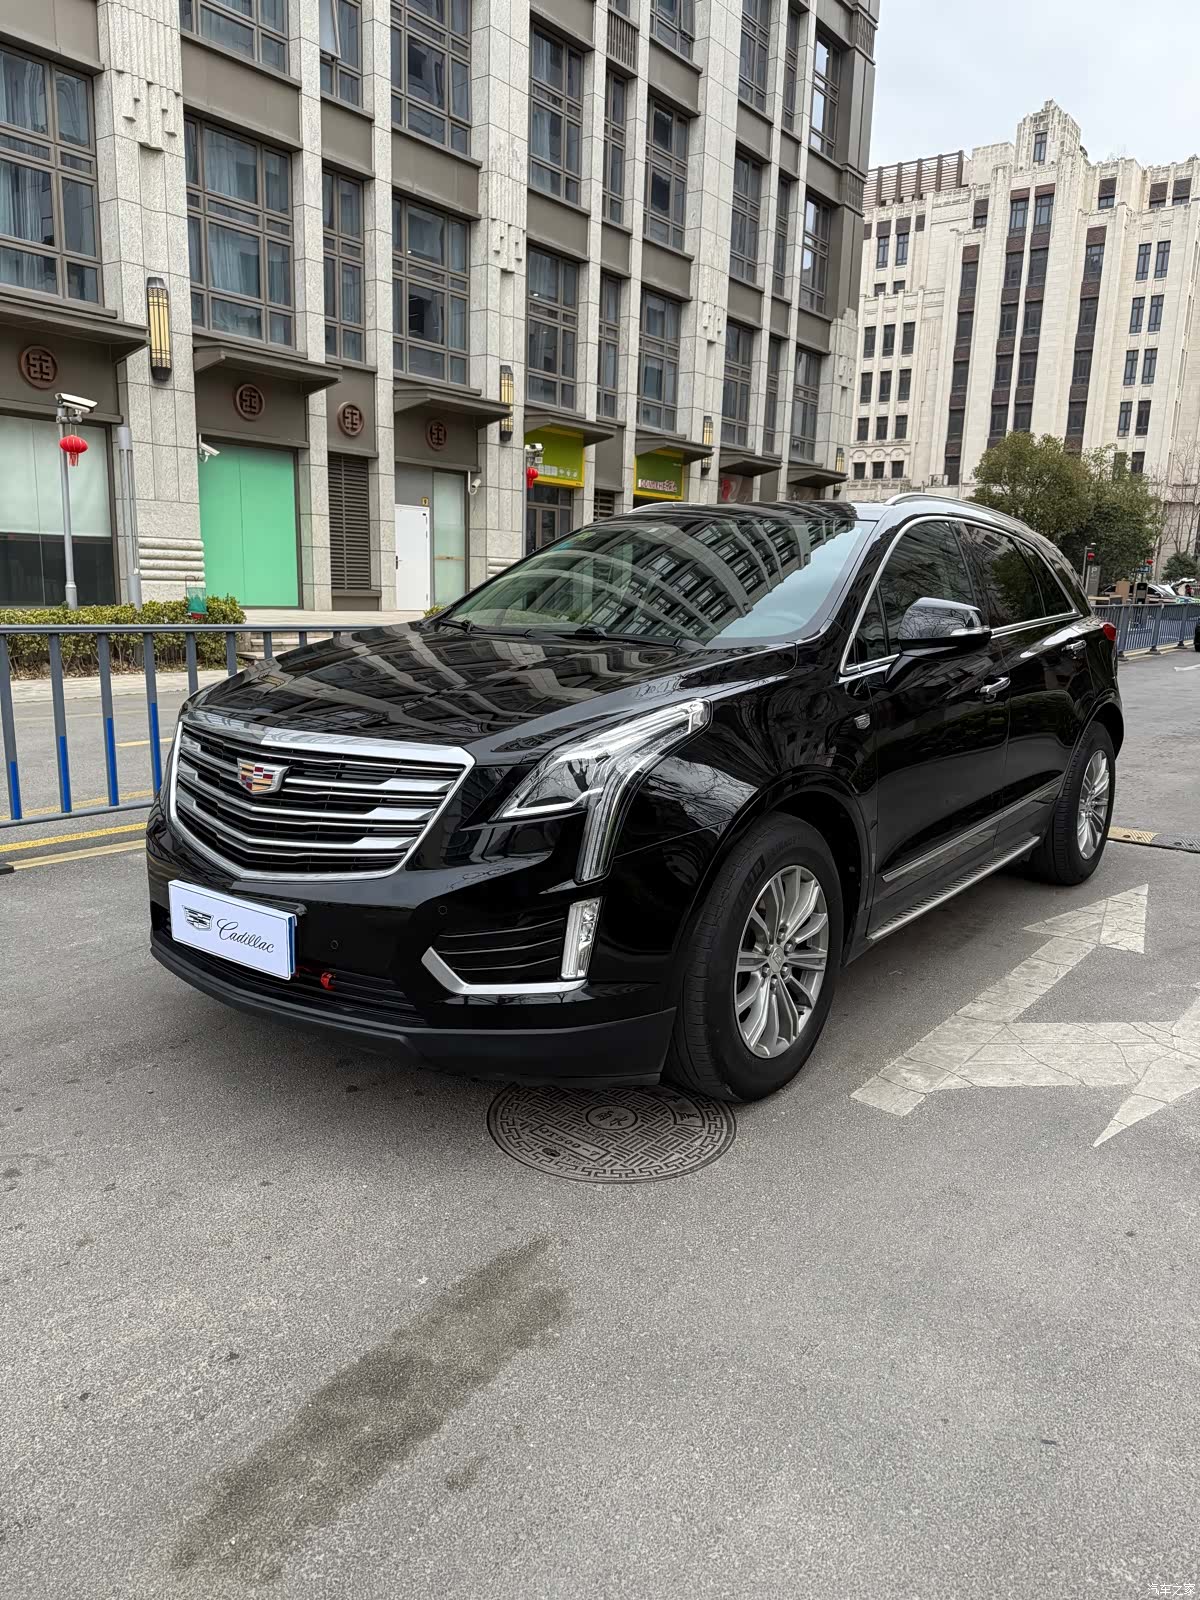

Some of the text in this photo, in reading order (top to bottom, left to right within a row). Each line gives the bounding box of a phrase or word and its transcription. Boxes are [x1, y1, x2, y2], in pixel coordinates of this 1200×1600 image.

[216, 918, 275, 954] Cadillac
[594, 1110, 629, 1127] 雨水
[538, 1126, 601, 1157] QT500-7
